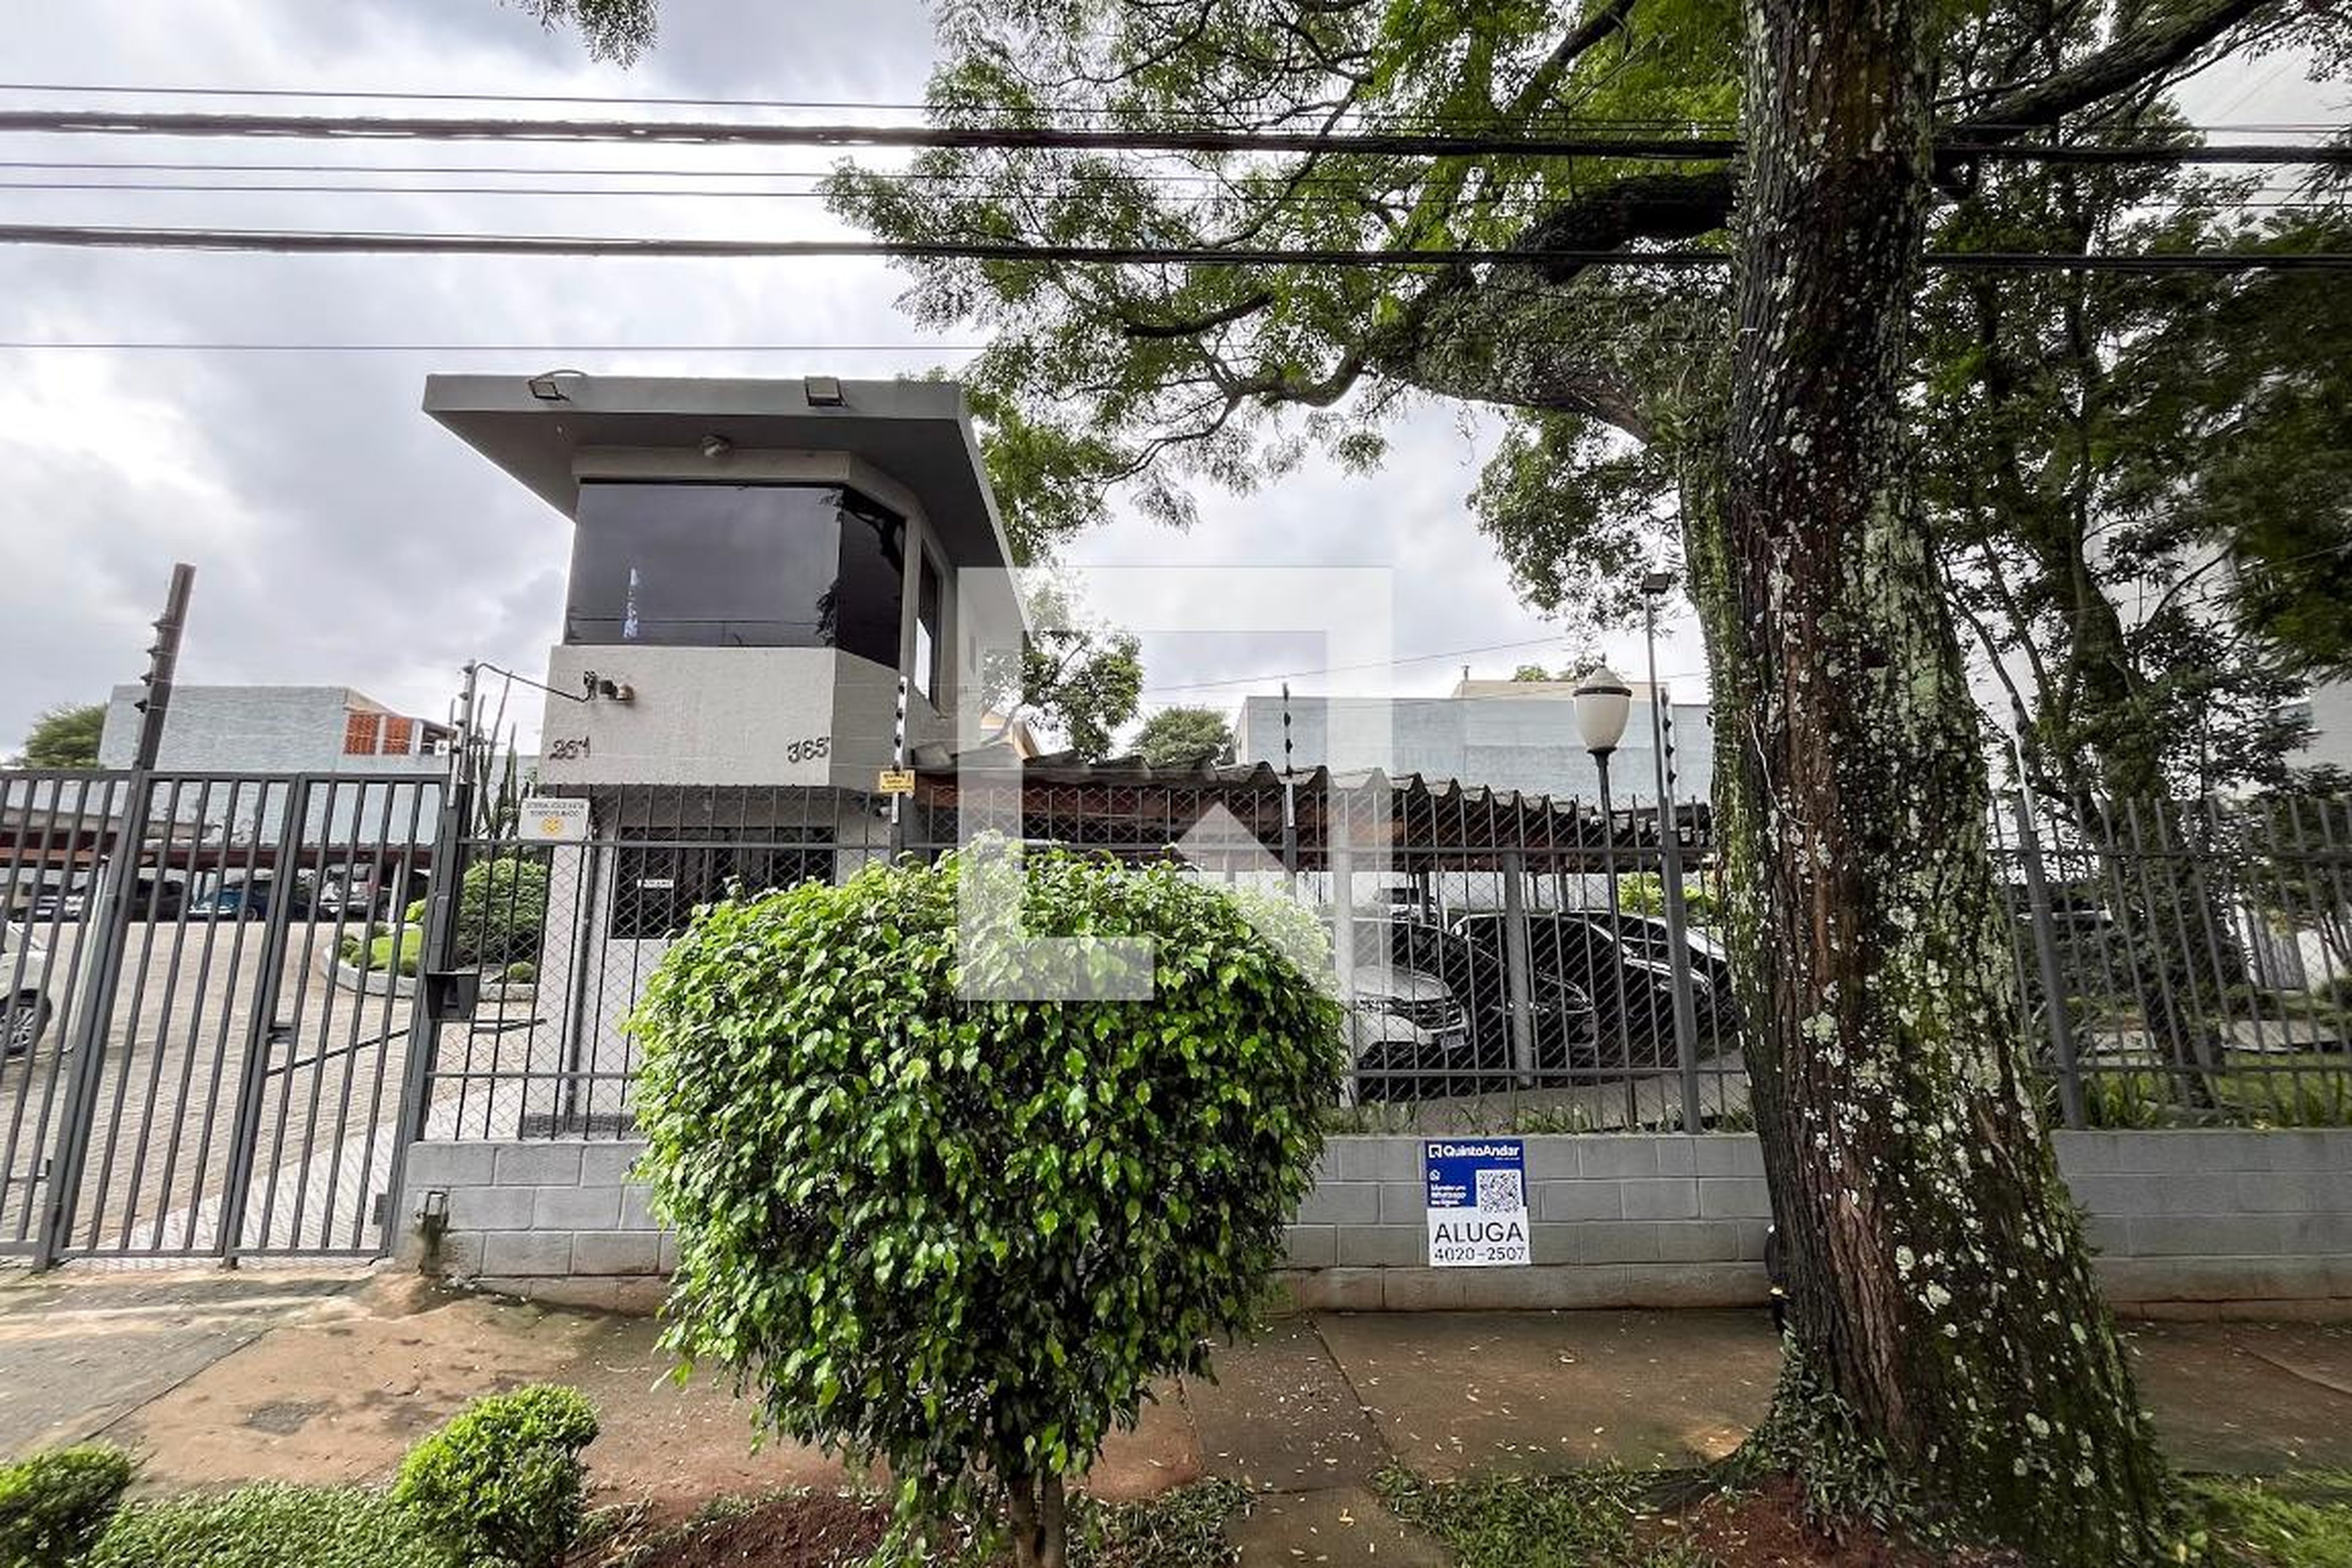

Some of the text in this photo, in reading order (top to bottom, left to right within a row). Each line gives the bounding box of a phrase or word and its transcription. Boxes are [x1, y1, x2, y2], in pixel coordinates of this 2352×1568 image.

[787, 736, 829, 763] 365
[1443, 1145, 1520, 1156] QuintoAndar
[1434, 1222, 1524, 1243] ALUGA
[1434, 1246, 1525, 1261] 4020-2507
